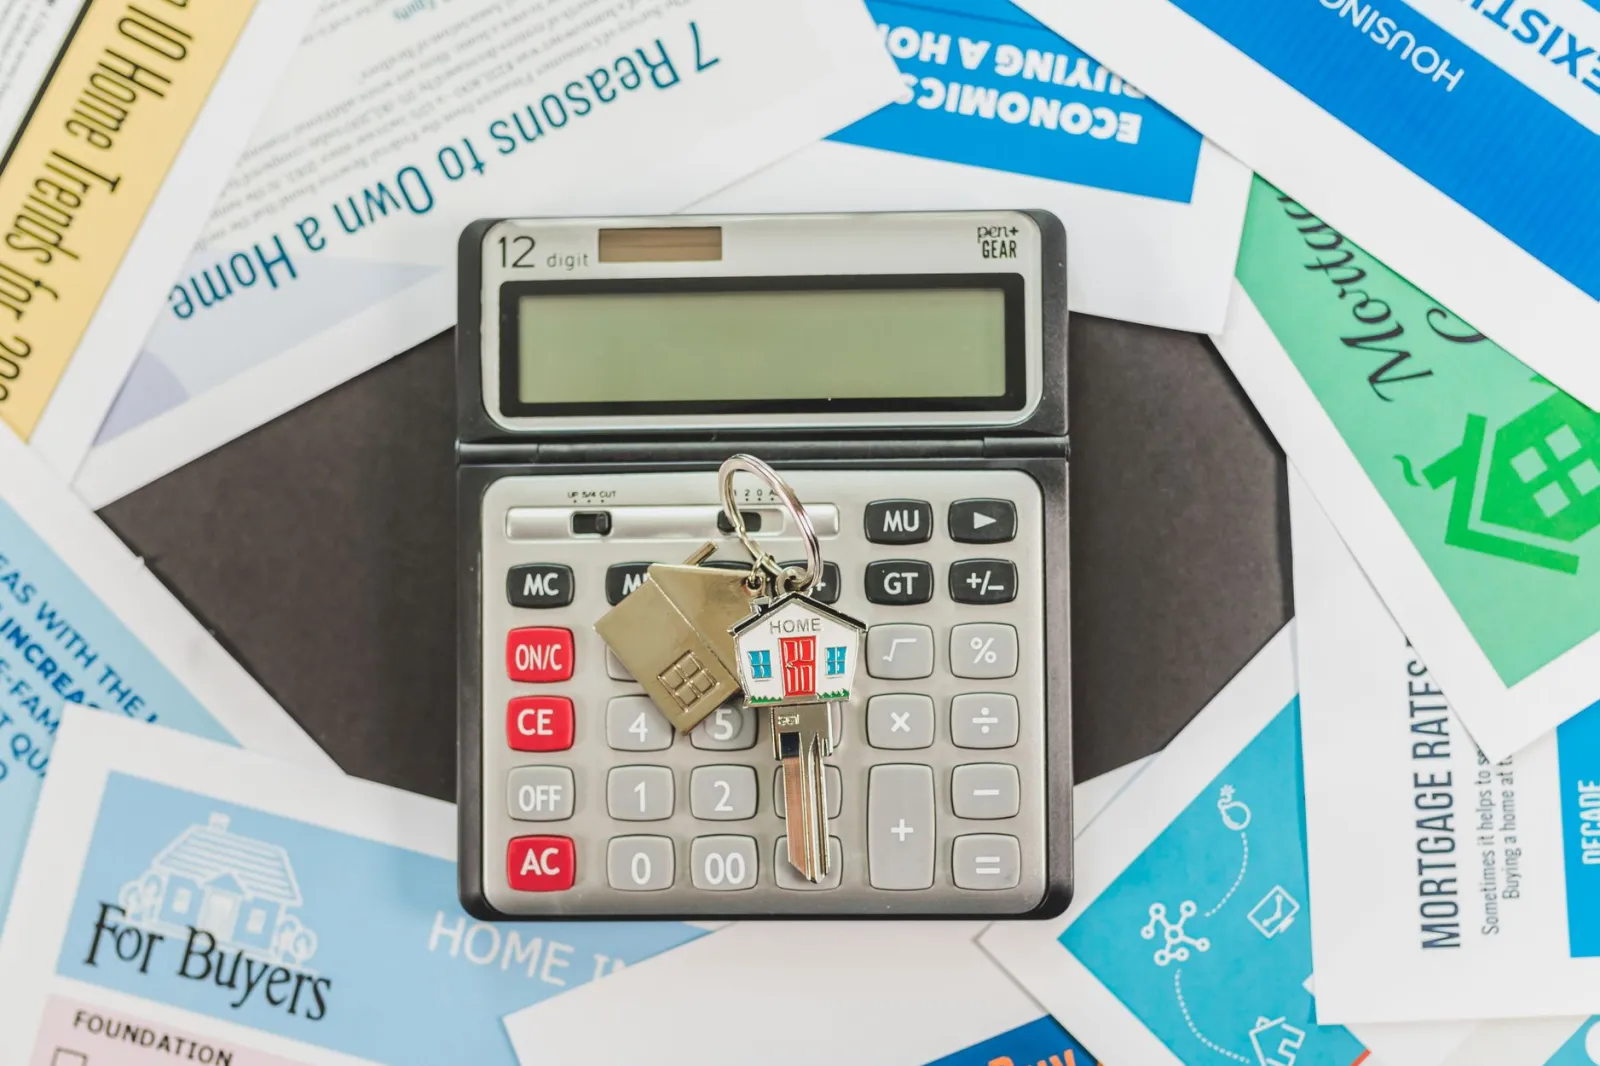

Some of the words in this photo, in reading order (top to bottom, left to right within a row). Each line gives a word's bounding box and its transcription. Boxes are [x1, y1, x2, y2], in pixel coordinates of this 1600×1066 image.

[118, 4, 194, 61] 10
[689, 21, 721, 73] 7
[877, 23, 951, 66] HO
[957, 37, 991, 71] A
[64, 48, 173, 151] Home
[489, 38, 682, 156] Reasons
[893, 72, 1143, 145] ECONOMICS
[438, 137, 487, 182] to
[4, 151, 121, 265] Trends
[332, 165, 436, 235] Own
[295, 215, 328, 253] a
[497, 235, 536, 269] 12
[546, 251, 589, 271] digit
[981, 240, 1018, 259] GEAR
[167, 234, 299, 321] Home
[883, 509, 920, 532] MU
[523, 573, 559, 596] MC
[883, 572, 918, 595] GT
[769, 617, 822, 635] HOME
[0, 616, 101, 709] INCREA
[36, 599, 99, 669] WITH
[98, 663, 146, 718] THE
[515, 644, 562, 670] ON/C
[970, 637, 997, 663] %
[517, 709, 554, 736] CE
[628, 712, 648, 743] 4
[713, 708, 733, 741] 5
[10, 733, 49, 778] QU
[713, 781, 734, 811] 2
[1474, 769, 1492, 786] to
[518, 784, 563, 812] OFF
[633, 781, 646, 813] 1
[1475, 789, 1496, 831] helps
[1499, 789, 1517, 831] home
[1476, 835, 1495, 846] it
[1504, 835, 1517, 845] a
[520, 848, 560, 876] AC
[631, 852, 651, 885] 0
[704, 852, 746, 885] 00
[1412, 771, 1461, 949] MORTGAGE
[1502, 848, 1521, 900] Buying
[1481, 850, 1499, 935] Sometimes
[83, 899, 165, 975] For
[177, 925, 332, 1021] Buyers
[428, 910, 575, 987] HOME
[73, 1009, 233, 1066] FOUNDATION
